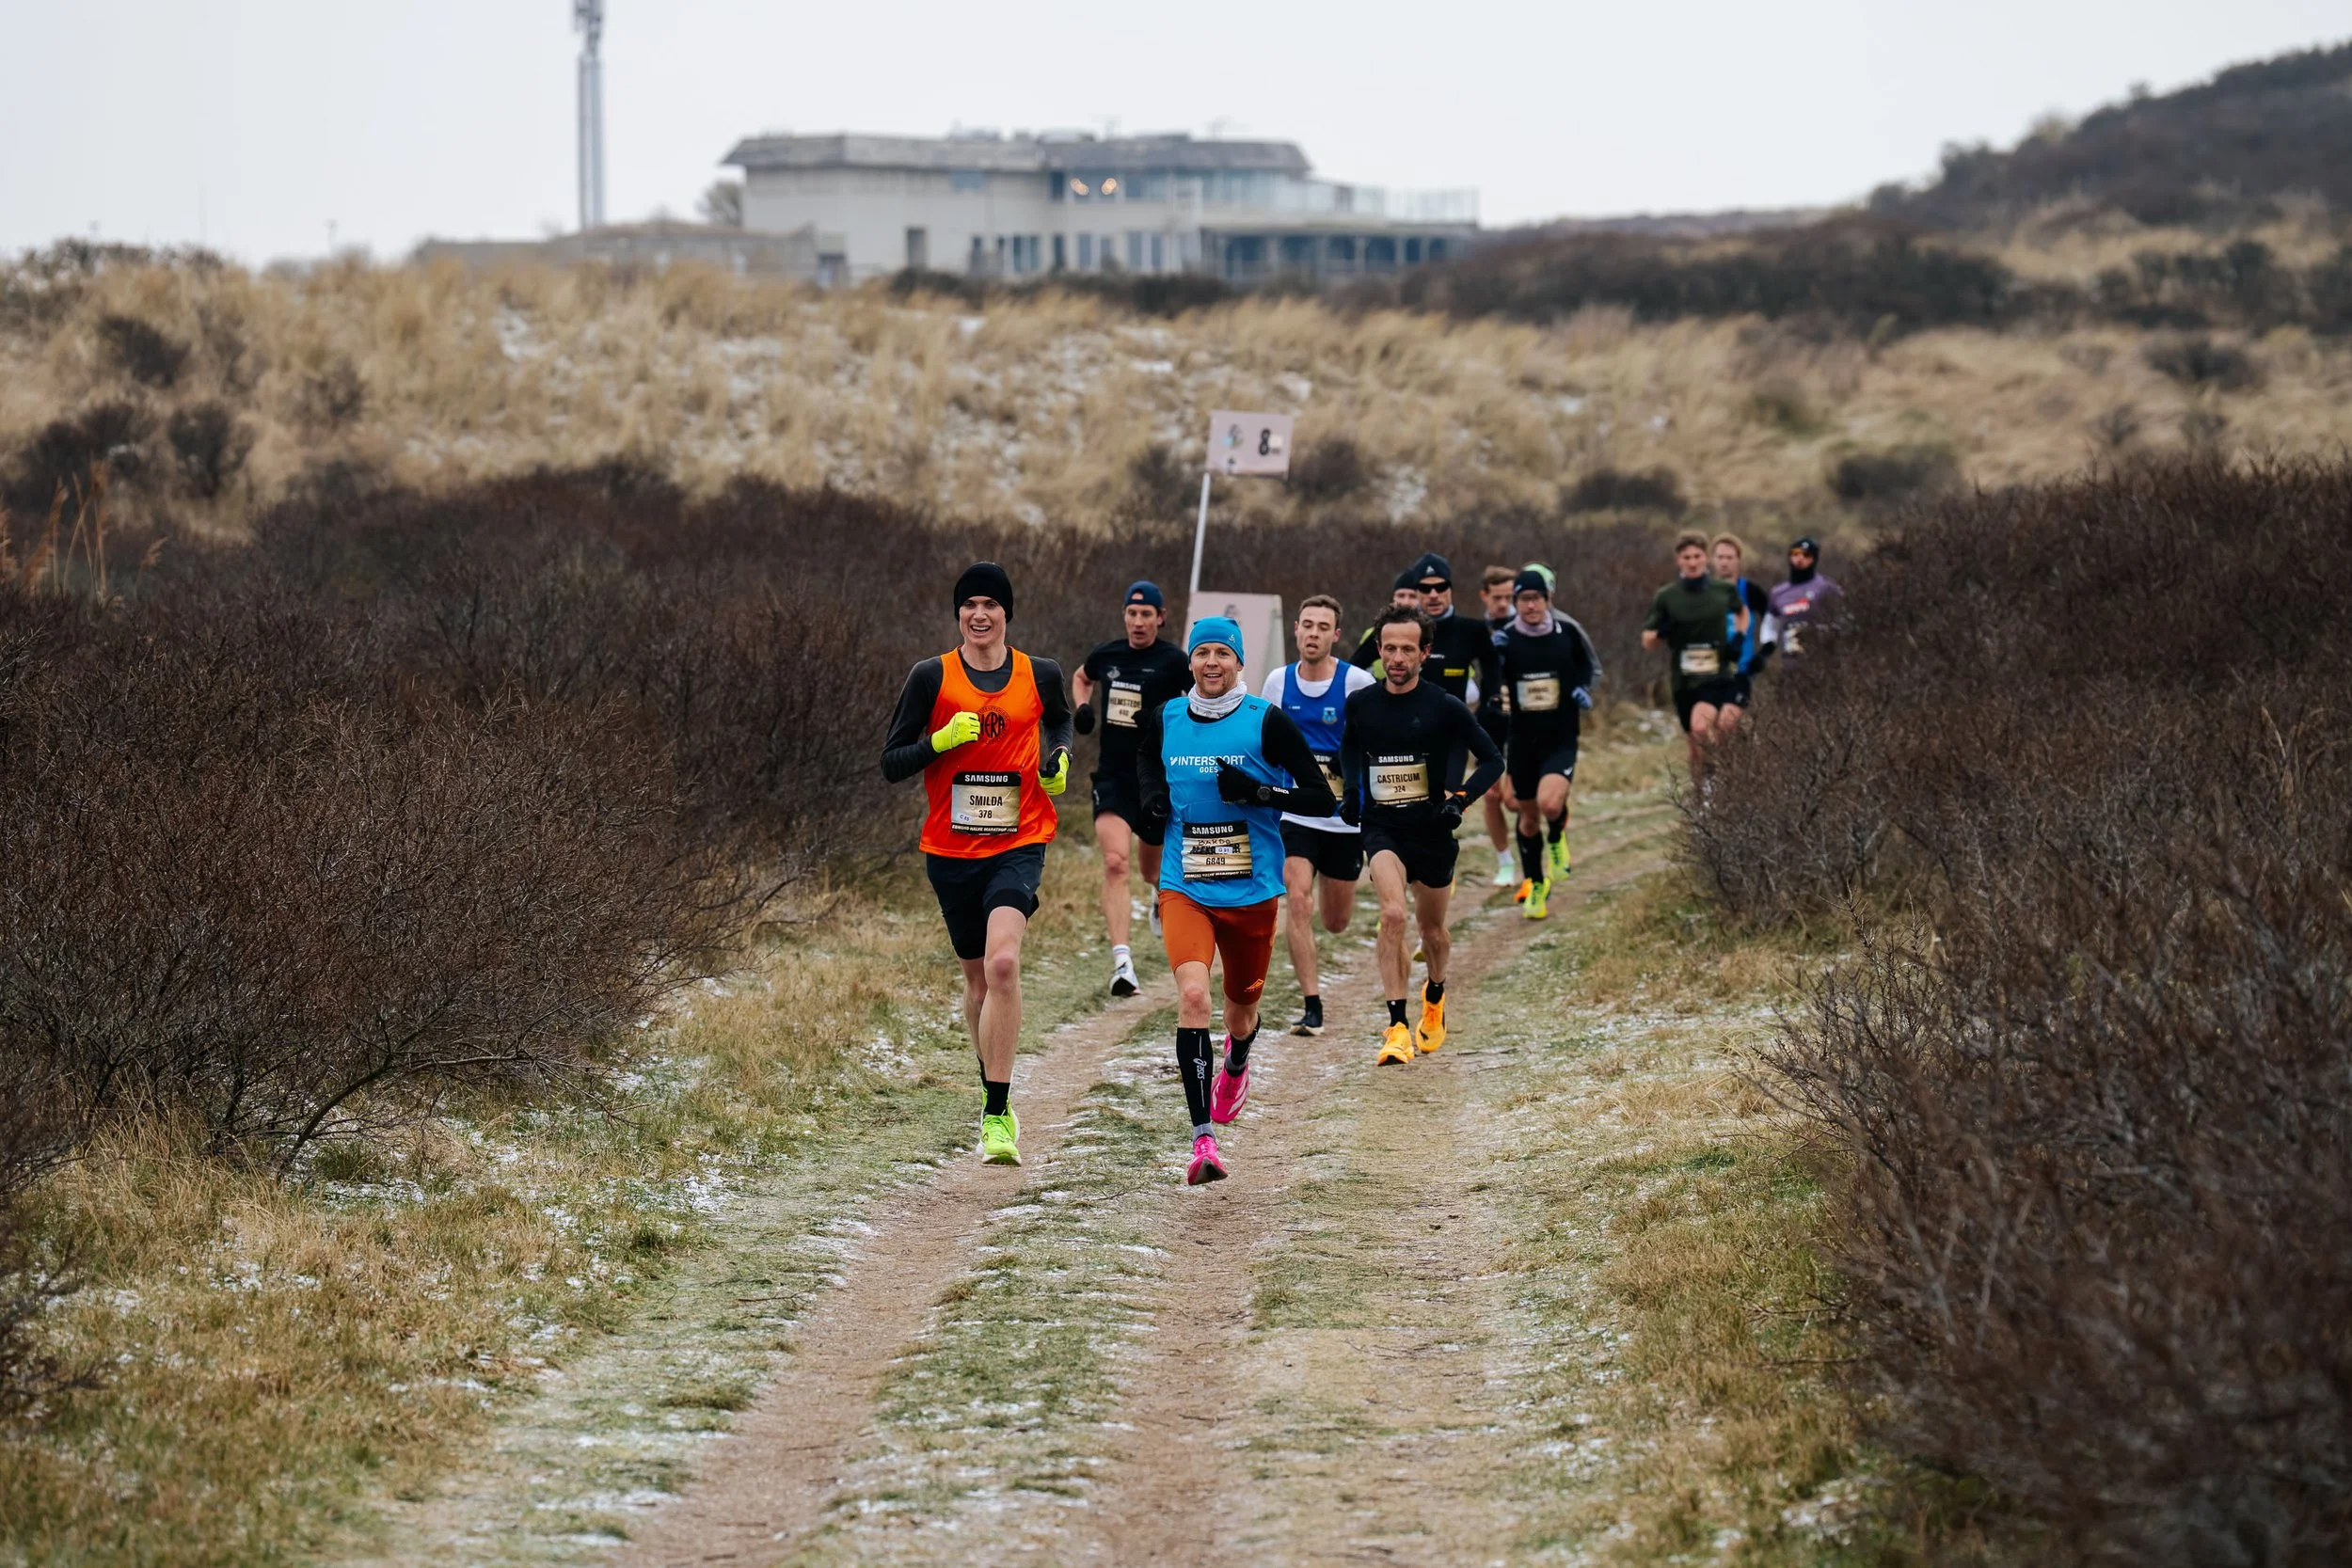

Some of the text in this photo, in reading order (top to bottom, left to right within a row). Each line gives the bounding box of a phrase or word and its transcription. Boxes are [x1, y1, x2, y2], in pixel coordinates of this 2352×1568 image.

[1178, 755, 1246, 767] INTERSORT
[1378, 755, 1414, 764] SAMSUNG
[964, 774, 1009, 783] SAMSUNG
[1377, 772, 1421, 784] CASTRICUM
[969, 795, 1003, 806] SMILDA
[978, 810, 993, 818] 378
[1191, 825, 1233, 834] SAMSUNG
[1205, 857, 1226, 865] 6849
